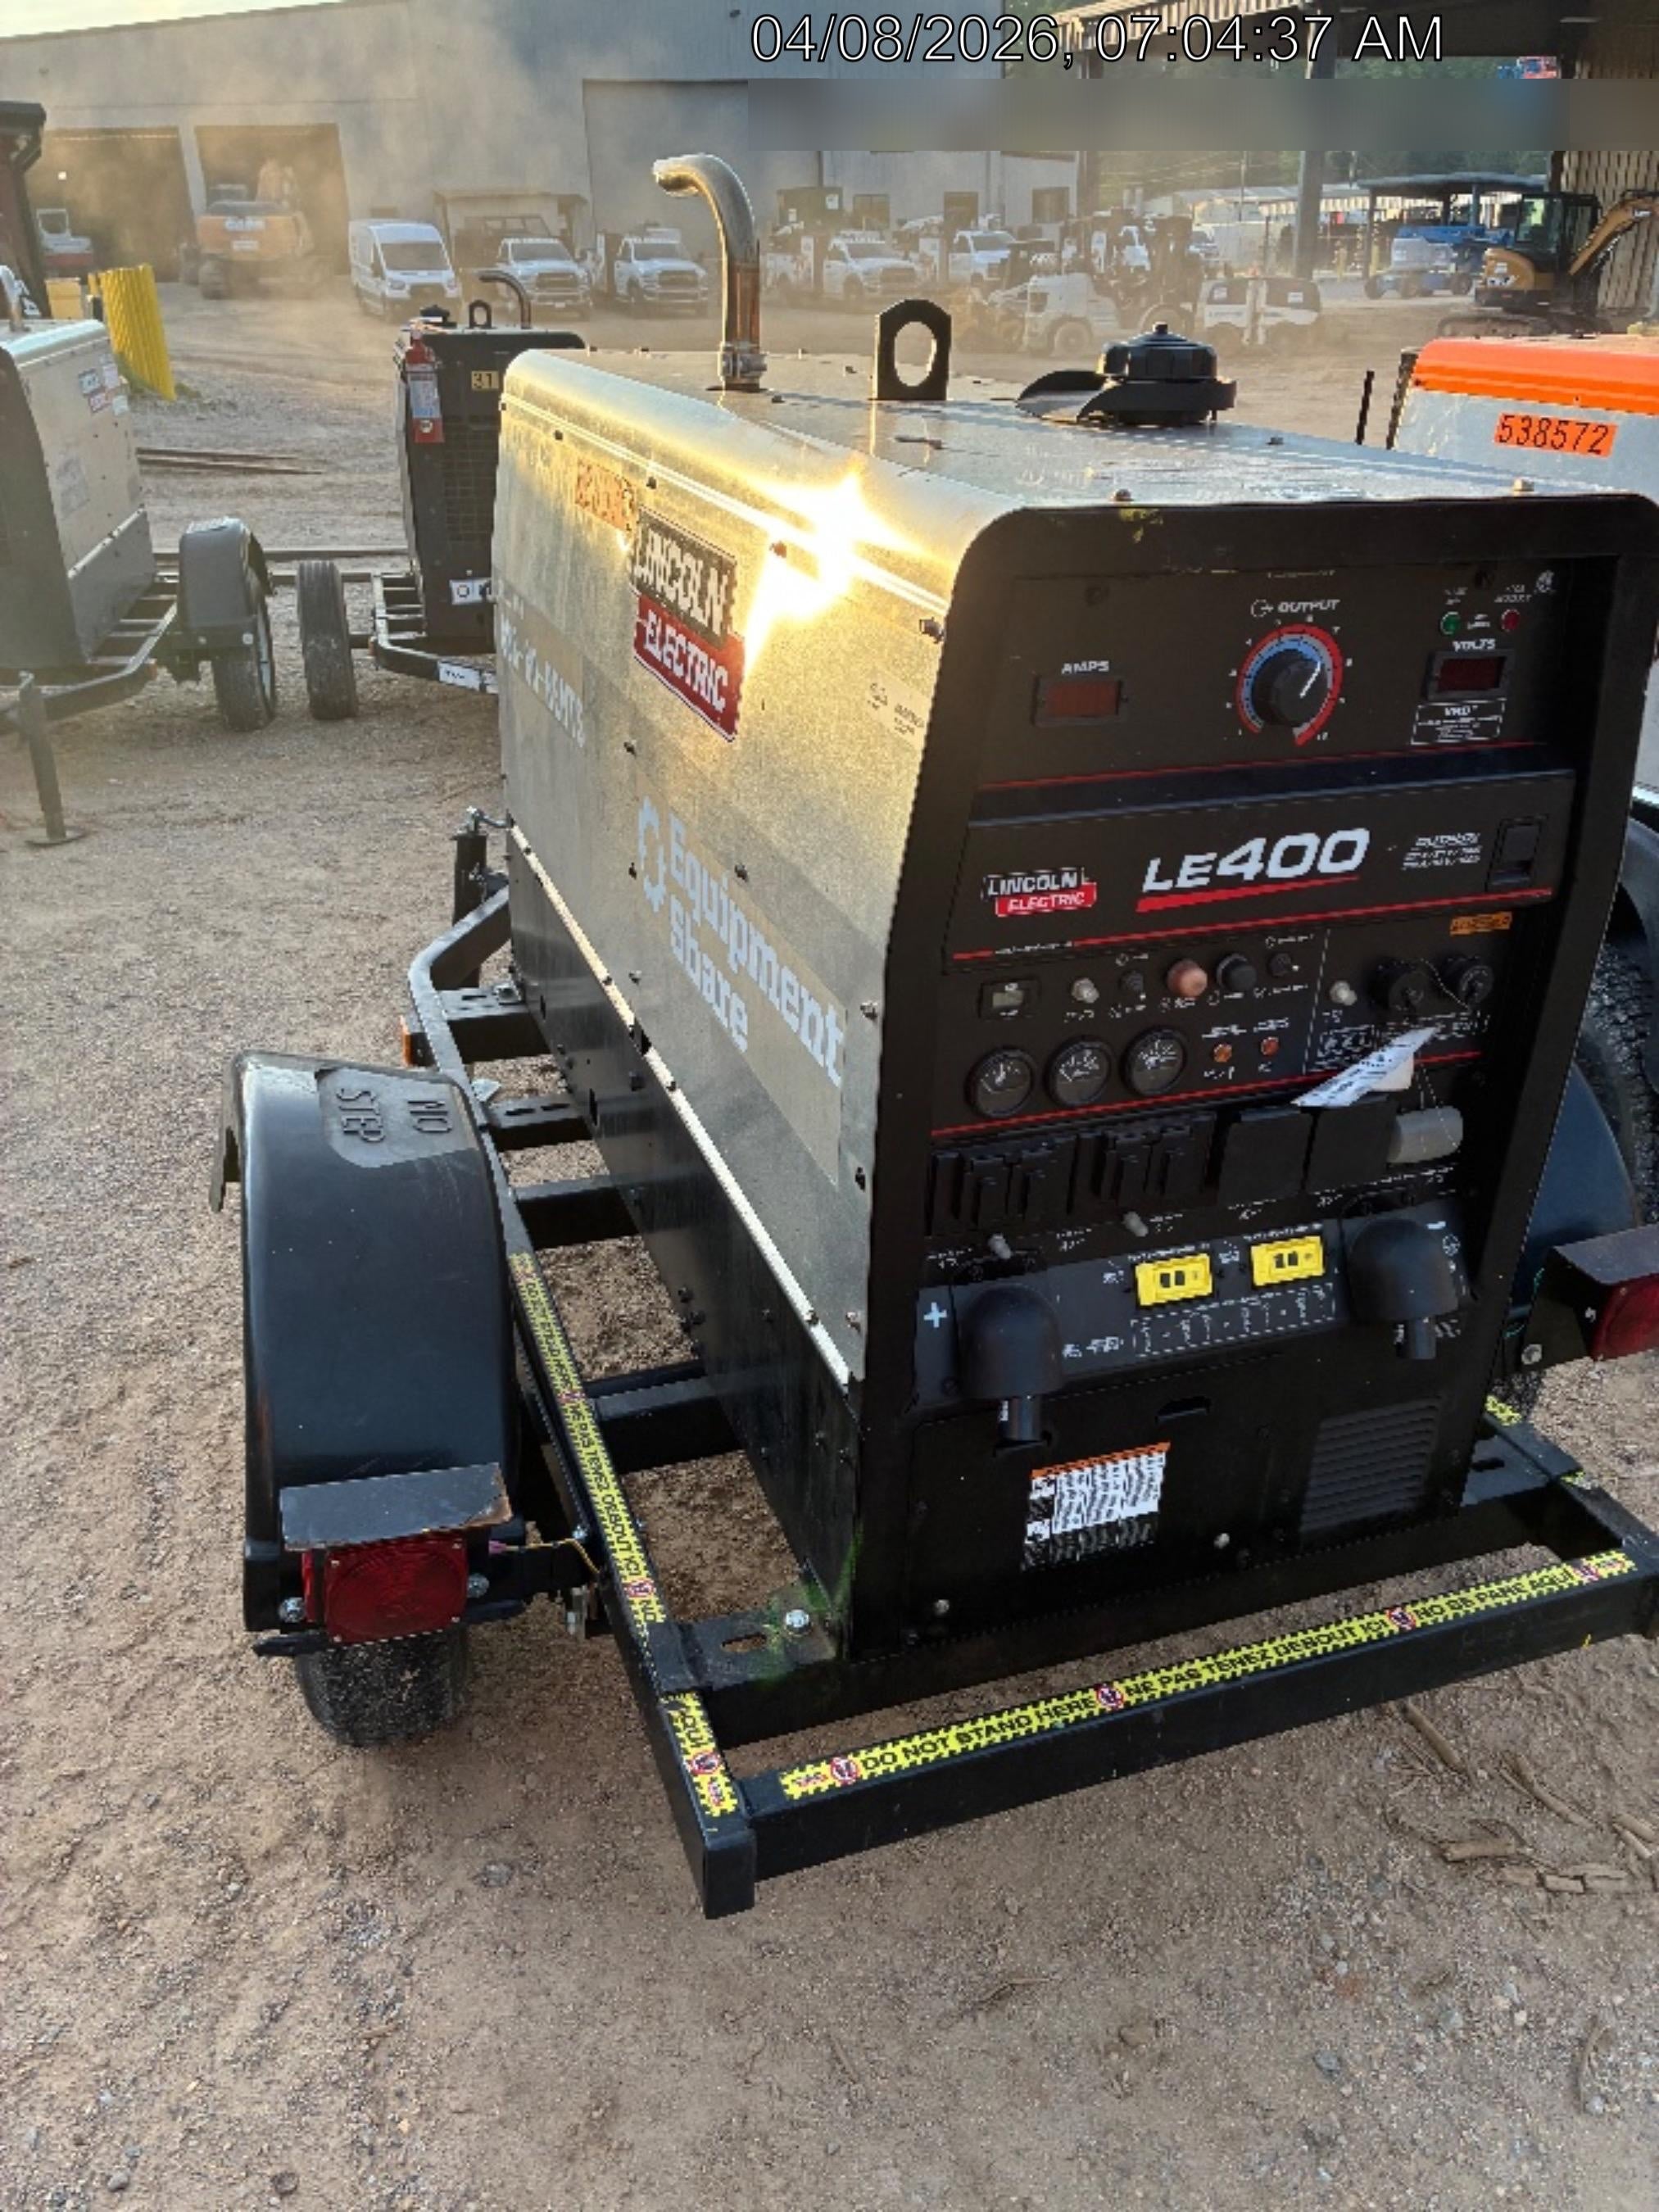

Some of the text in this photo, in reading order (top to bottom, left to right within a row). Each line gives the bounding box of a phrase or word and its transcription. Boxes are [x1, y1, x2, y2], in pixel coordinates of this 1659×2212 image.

[1498, 414, 1609, 456] 538572
[633, 528, 728, 636] LINCOLN
[643, 610, 729, 714] ELECTRIC
[1061, 660, 1110, 674] AMPS
[986, 870, 1079, 897] LINCOLN
[1143, 827, 1371, 894] LE400
[1008, 892, 1086, 912] ELECTRIC
[669, 811, 844, 1089] Equipment
[669, 895, 749, 1054] Share
[334, 1087, 386, 1144] STEP
[406, 1099, 452, 1133] NO
[861, 1697, 1096, 1771] DO NOT STAND HERE
